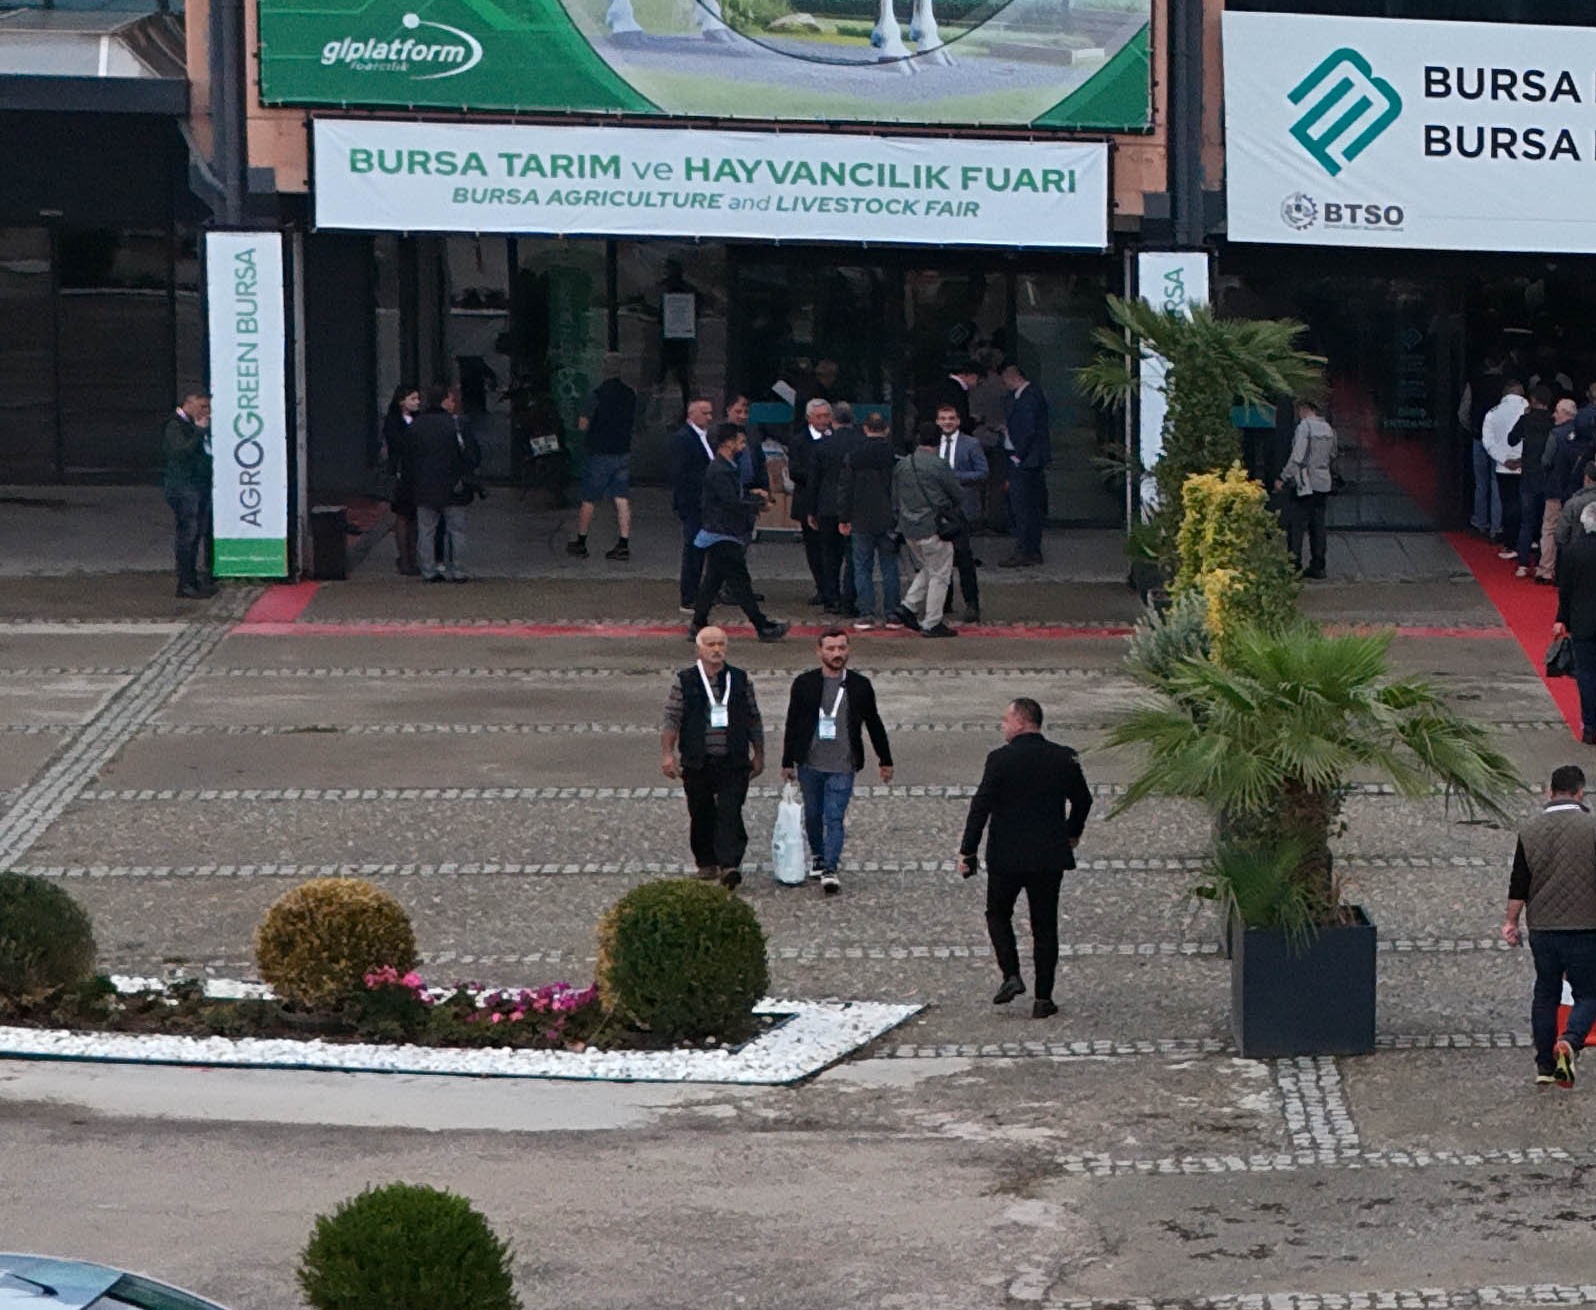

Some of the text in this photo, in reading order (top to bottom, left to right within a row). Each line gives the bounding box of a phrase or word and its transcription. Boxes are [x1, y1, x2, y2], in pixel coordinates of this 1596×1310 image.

[1423, 66, 1580, 103] BURSA
[1423, 125, 1580, 162] BURSA
[349, 148, 1077, 193] BURSA TARIM ve HAYVANCILIK FUARI
[452, 187, 980, 217] BURSA AGRICULTURE and LIVESTOCK FAIR
[1324, 202, 1404, 226] BTSO
[234, 248, 258, 334] BURSA
[1164, 267, 1184, 316] RSA
[233, 343, 264, 527] AGROGREEN
